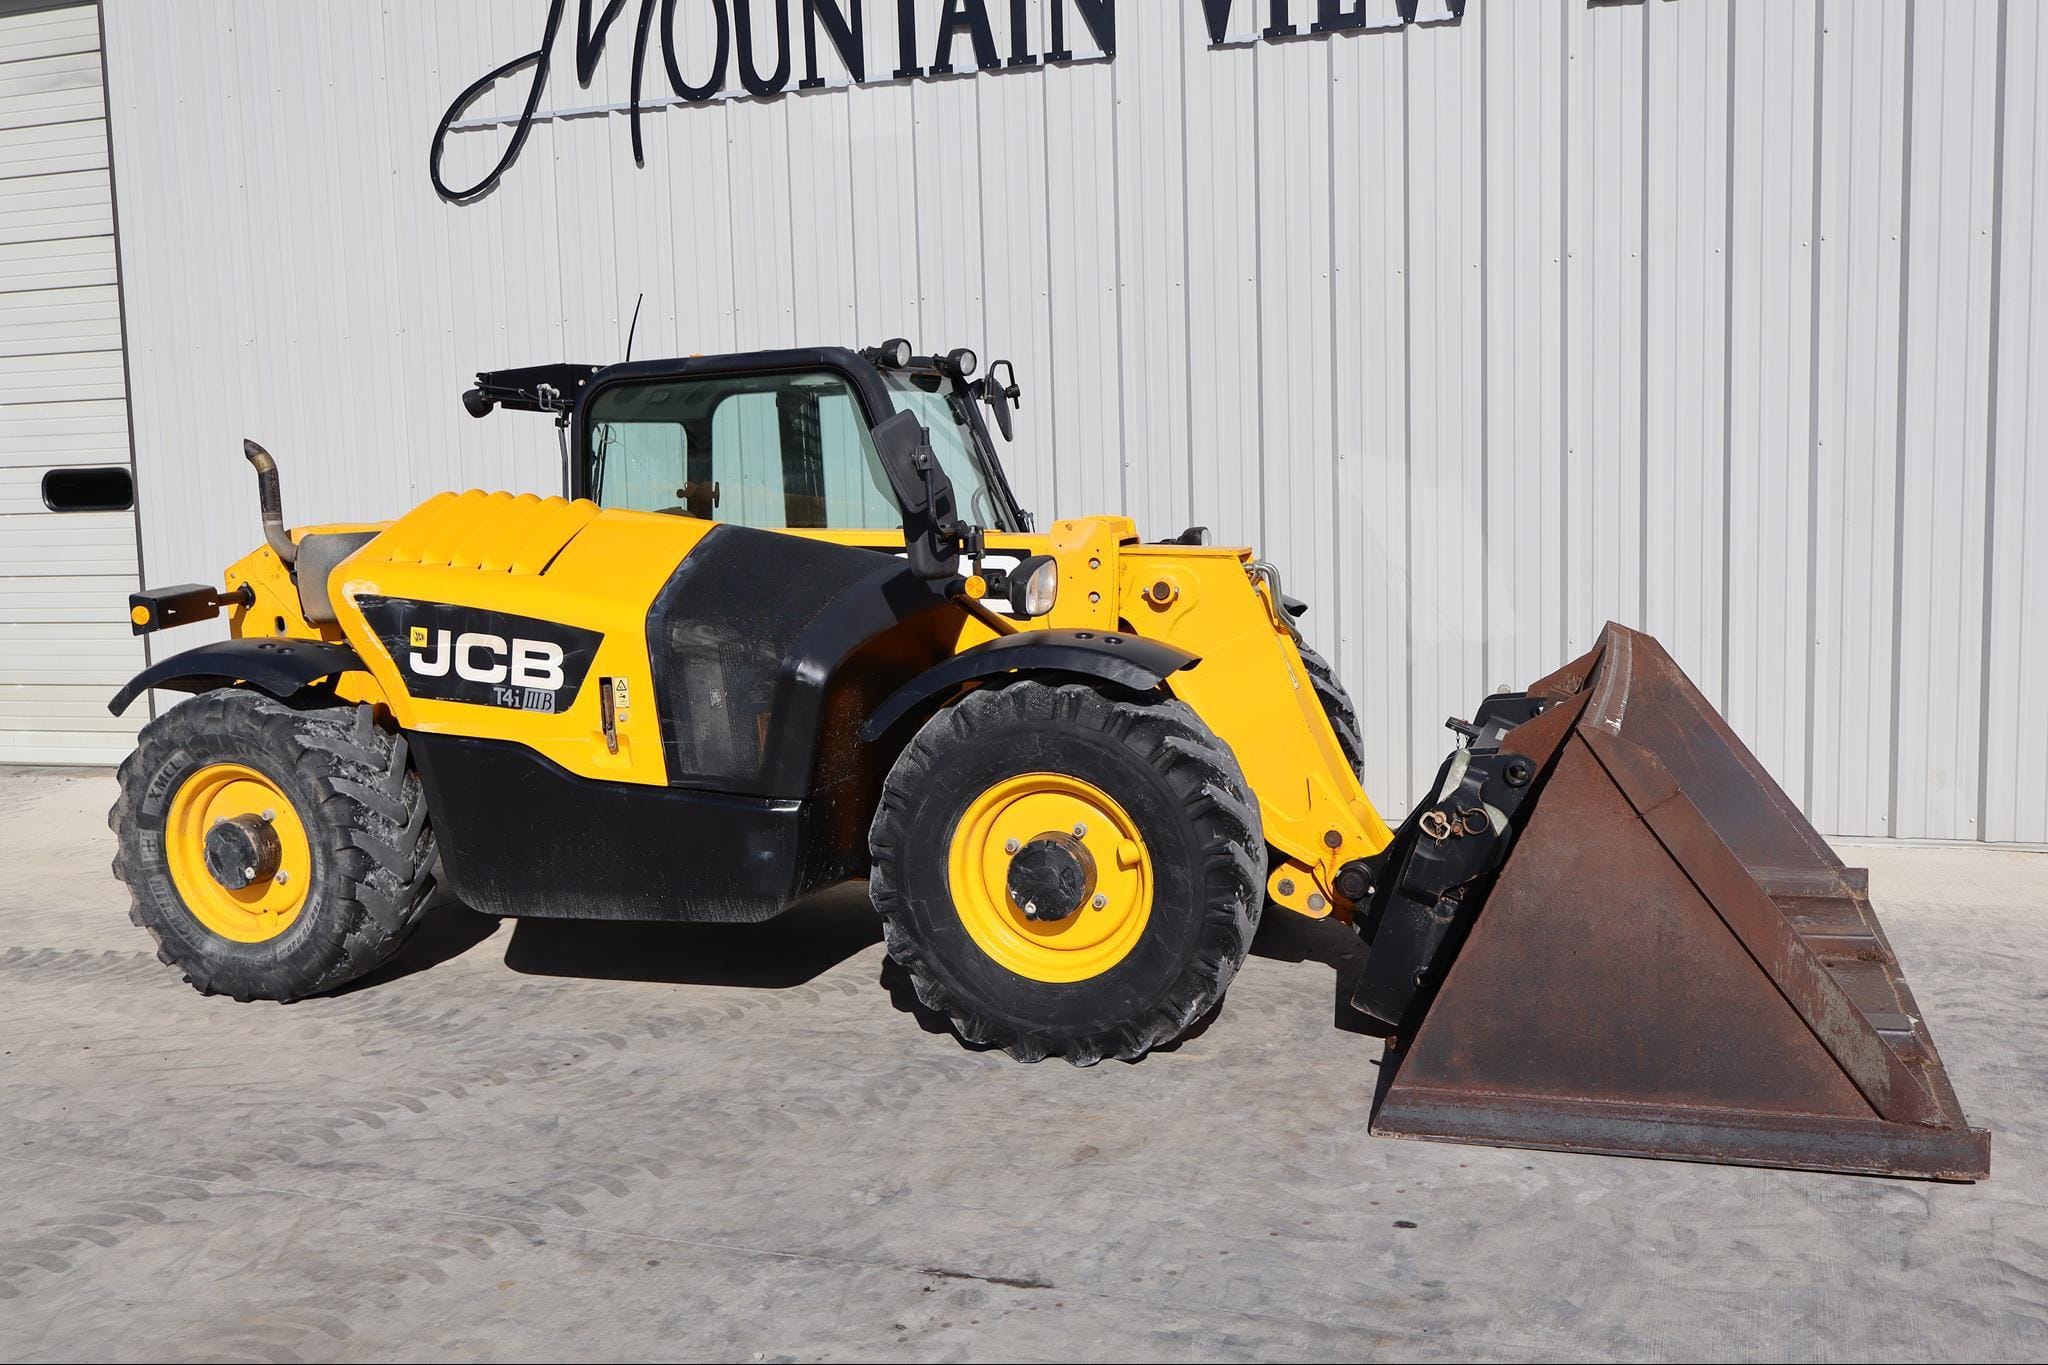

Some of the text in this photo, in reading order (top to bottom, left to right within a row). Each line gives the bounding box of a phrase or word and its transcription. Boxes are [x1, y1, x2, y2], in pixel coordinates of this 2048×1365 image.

[410, 627, 564, 691] JCB
[493, 687, 520, 708] T4i
[148, 759, 182, 803] XMCL
